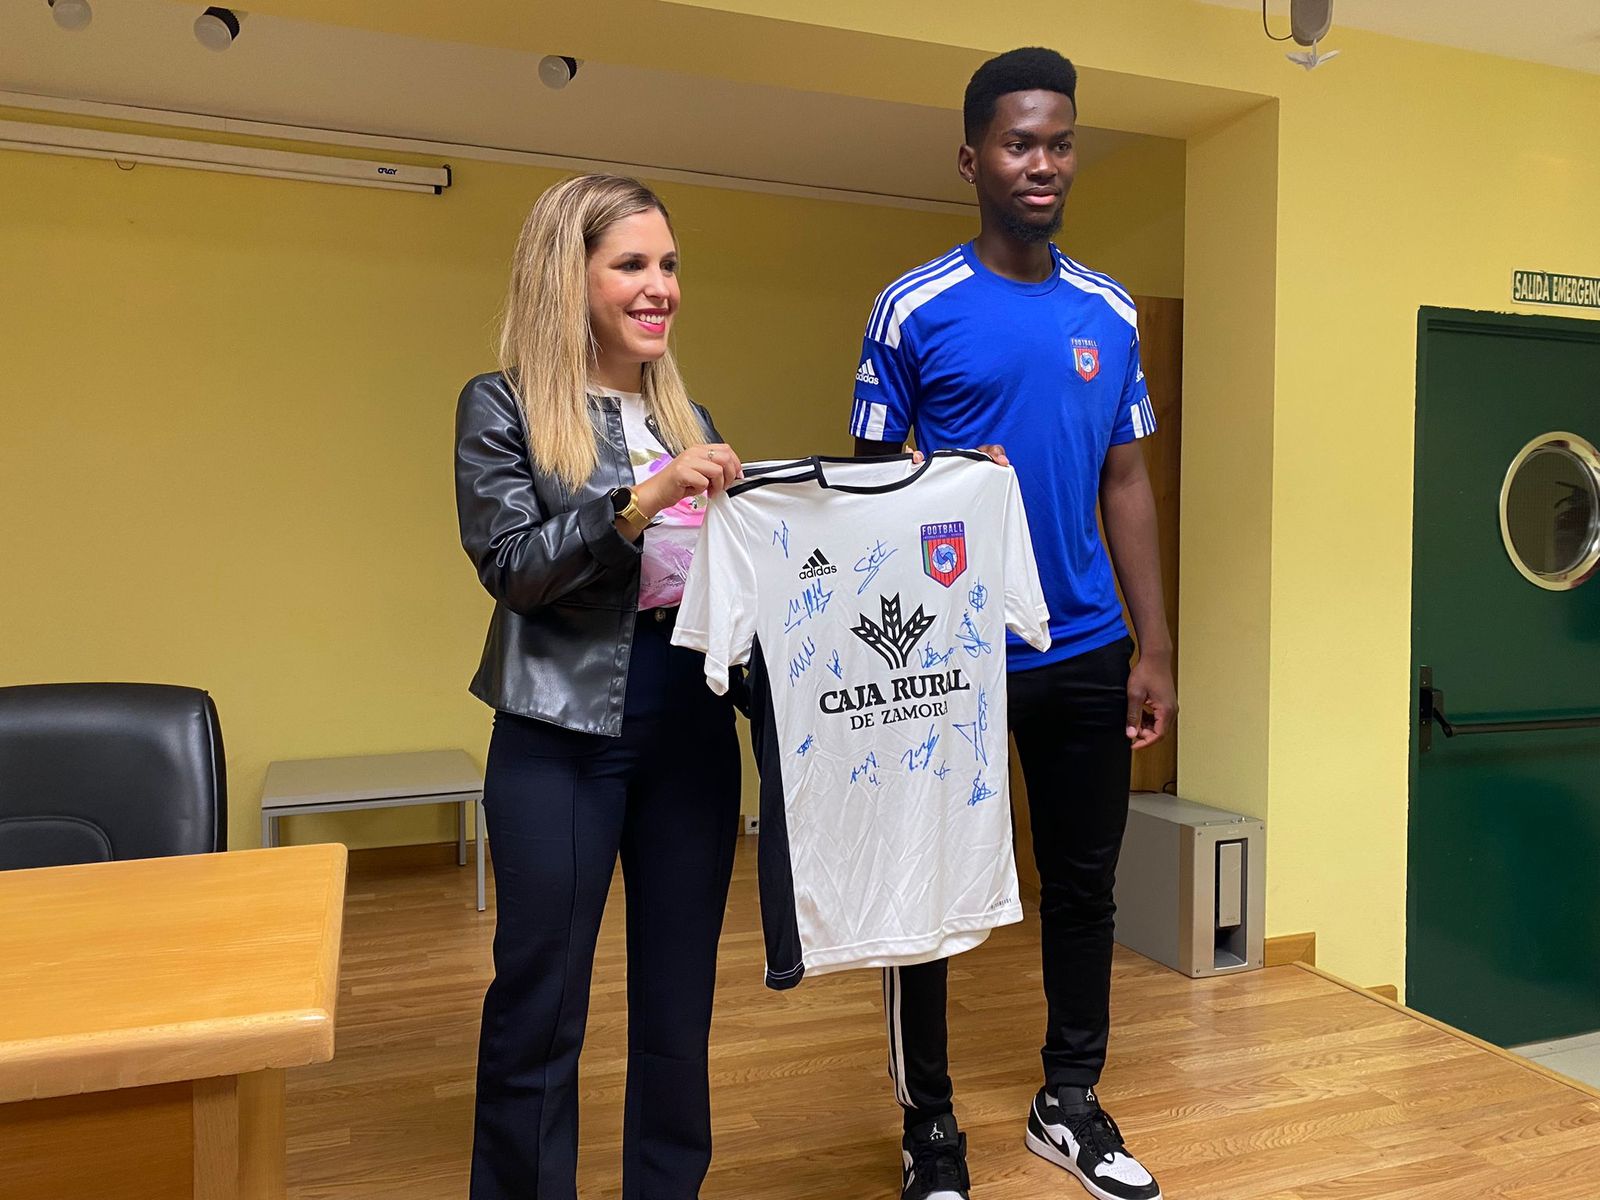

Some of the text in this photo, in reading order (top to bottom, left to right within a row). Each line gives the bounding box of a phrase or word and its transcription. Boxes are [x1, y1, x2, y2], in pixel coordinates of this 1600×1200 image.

[1515, 272, 1549, 301] SALIDA
[922, 522, 964, 536] FOOTBALL
[798, 565, 837, 579] adidas
[819, 668, 971, 714] CAJA RURAL
[850, 713, 875, 730] DE
